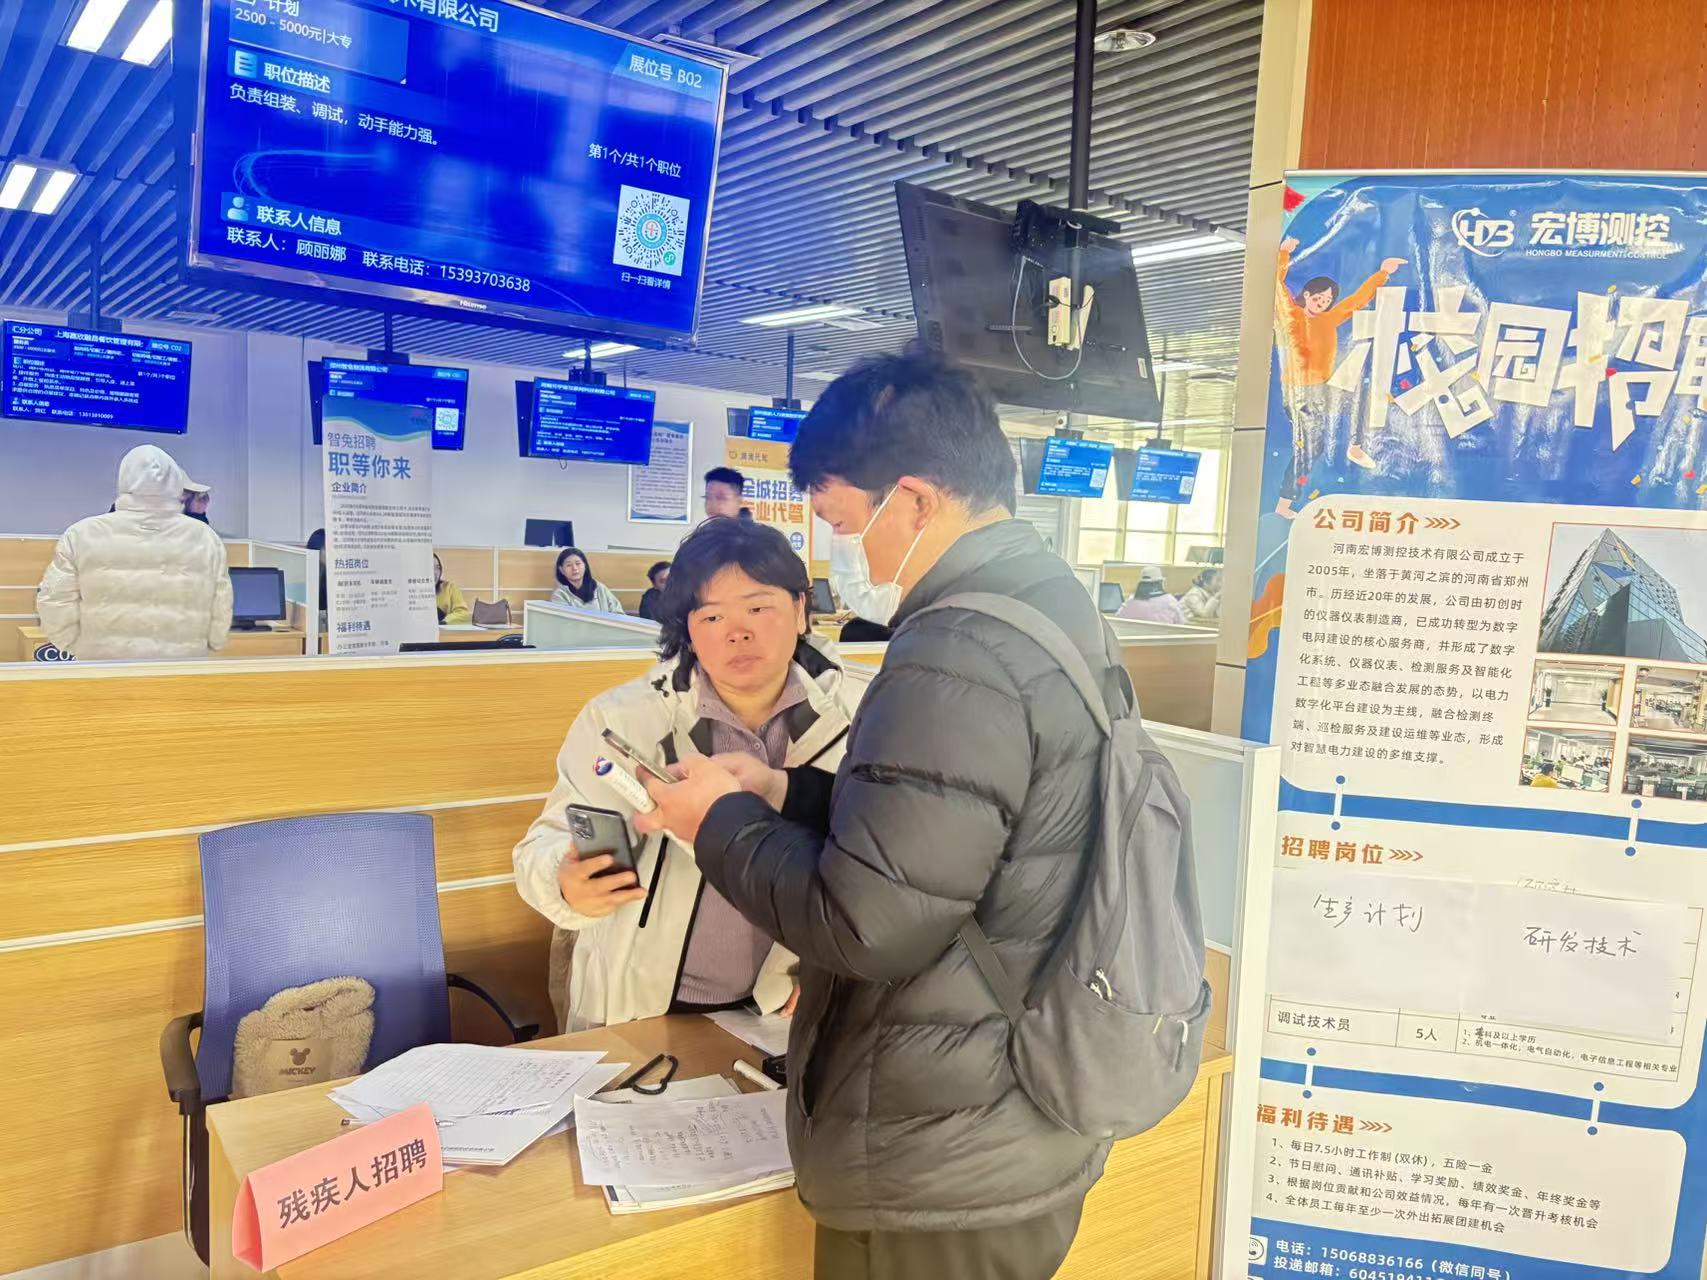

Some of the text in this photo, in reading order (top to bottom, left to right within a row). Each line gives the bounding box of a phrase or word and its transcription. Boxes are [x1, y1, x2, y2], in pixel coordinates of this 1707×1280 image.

[235, 7, 267, 26] 2500
[388, 0, 499, 33] 有限公司
[263, 61, 331, 94] 职位描述
[629, 54, 703, 89] 展位号 B02
[228, 83, 438, 146] 负责组装、调试，动手能力强。
[588, 143, 682, 177] 第1个/共1个职位
[256, 205, 342, 236] 联系人信息
[1528, 210, 1672, 248] 宏博测控
[226, 226, 531, 292] 联系人：顾丽娜 联系电话：15393703638
[1525, 249, 1563, 257] HONGBO
[327, 432, 376, 450] 智兔招聘
[327, 451, 411, 479] 职等你来
[331, 481, 367, 494] 企业简介
[1313, 508, 1419, 535] 公司简介
[1332, 542, 1524, 564] 河南宏博测控技术有限公司成立于
[1307, 564, 1529, 588] 2005年，坐落于黄河之滨的河南省郑州
[1305, 587, 1524, 611] 市。历经近20年的发展，公司由初创时
[1303, 609, 1518, 633] 的仪器仪表制造商，已成功转型为数字
[1301, 631, 1515, 656] 电网建设的核心服务商，并形成了数字
[1299, 653, 1512, 679] 化系统、仪器仪表、检测服务及智能化
[1296, 675, 1509, 701] 工程等多业态融合发展的态势，以电力
[1295, 697, 1494, 722] 数字化平台建设为主线，融合检测终
[1292, 719, 1504, 746] 端、巡检服务及建设运维等业态，形成
[1290, 741, 1446, 765] 对智慧电力建设的多维支撑。
[1281, 835, 1383, 864] 招聘岗位
[1312, 892, 1424, 933] 生产计划
[1522, 926, 1643, 956] 研发技术
[1277, 1010, 1350, 1032] 调试技术员
[1415, 1028, 1438, 1041] 5人
[278, 1067, 316, 1075] MICKEY
[1256, 1104, 1355, 1135] 福利待遇
[277, 1139, 427, 1229] 残疾人招聘
[1269, 1156, 1601, 1211] 2、节日慰问、通讯补贴、学习奖励、绩效奖金、年终奖金等
[1265, 1192, 1505, 1234] 4、全体员工每年至少一次外出拓展团建机会
[1267, 1174, 1599, 1230] 3、根据岗位贡献和公司效益情况，每年有一次晋升考核机会
